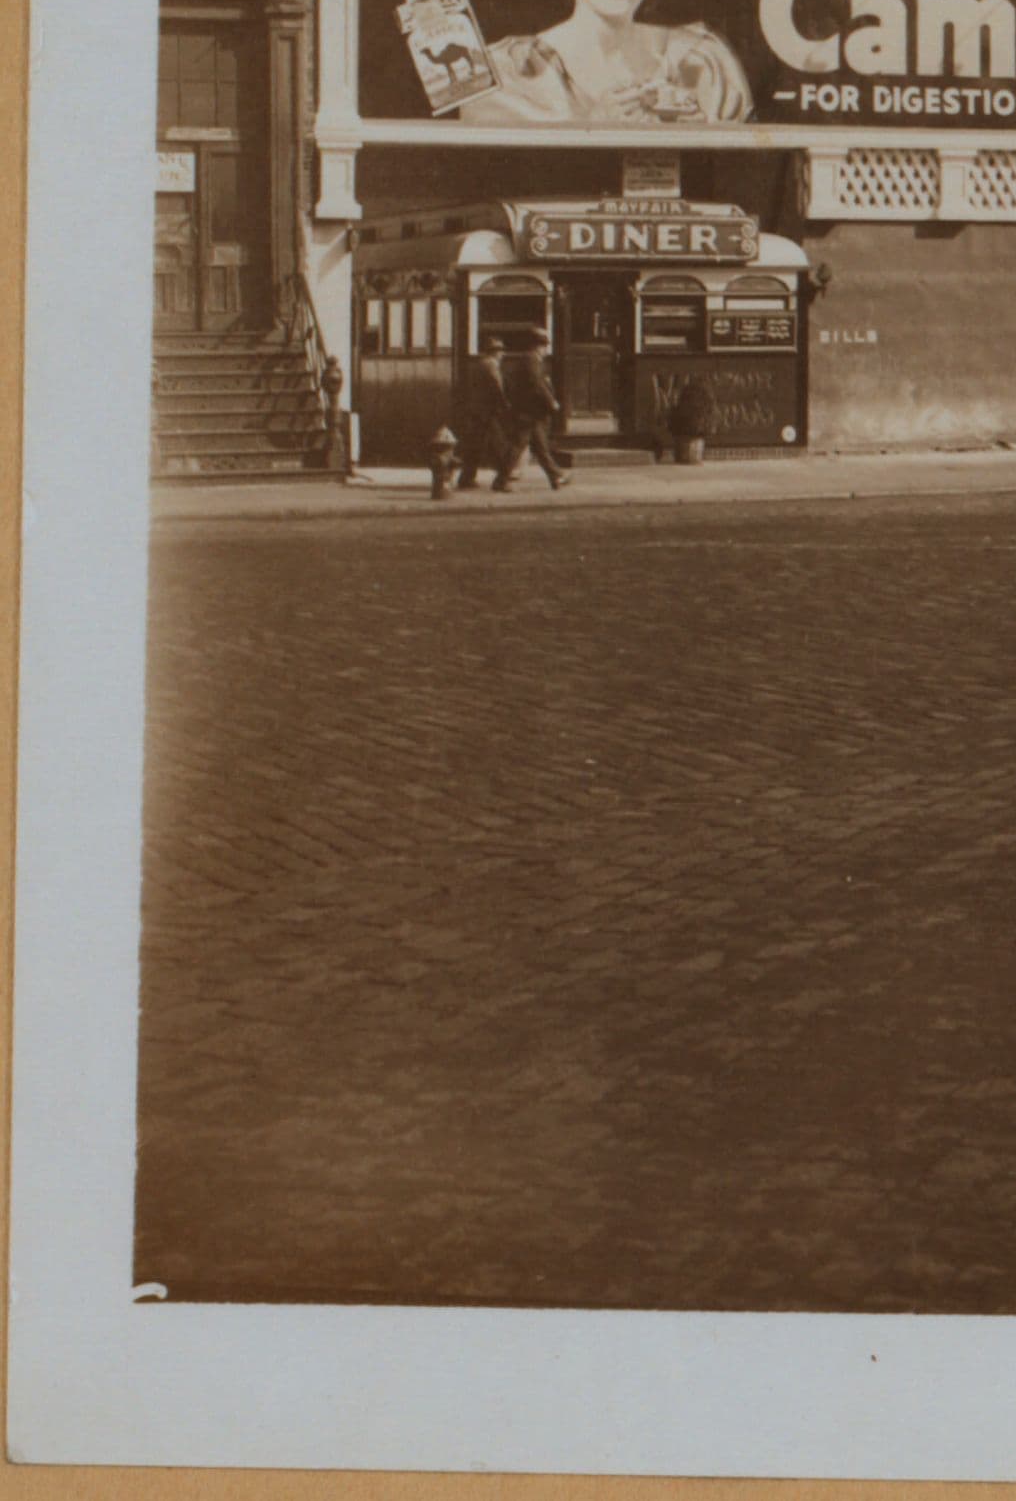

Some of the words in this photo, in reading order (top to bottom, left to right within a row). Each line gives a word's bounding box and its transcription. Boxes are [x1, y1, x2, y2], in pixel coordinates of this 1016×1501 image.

[604, 201, 683, 215] MAYFAIR
[570, 222, 719, 252] DINER
[819, 329, 878, 344] BILLS
